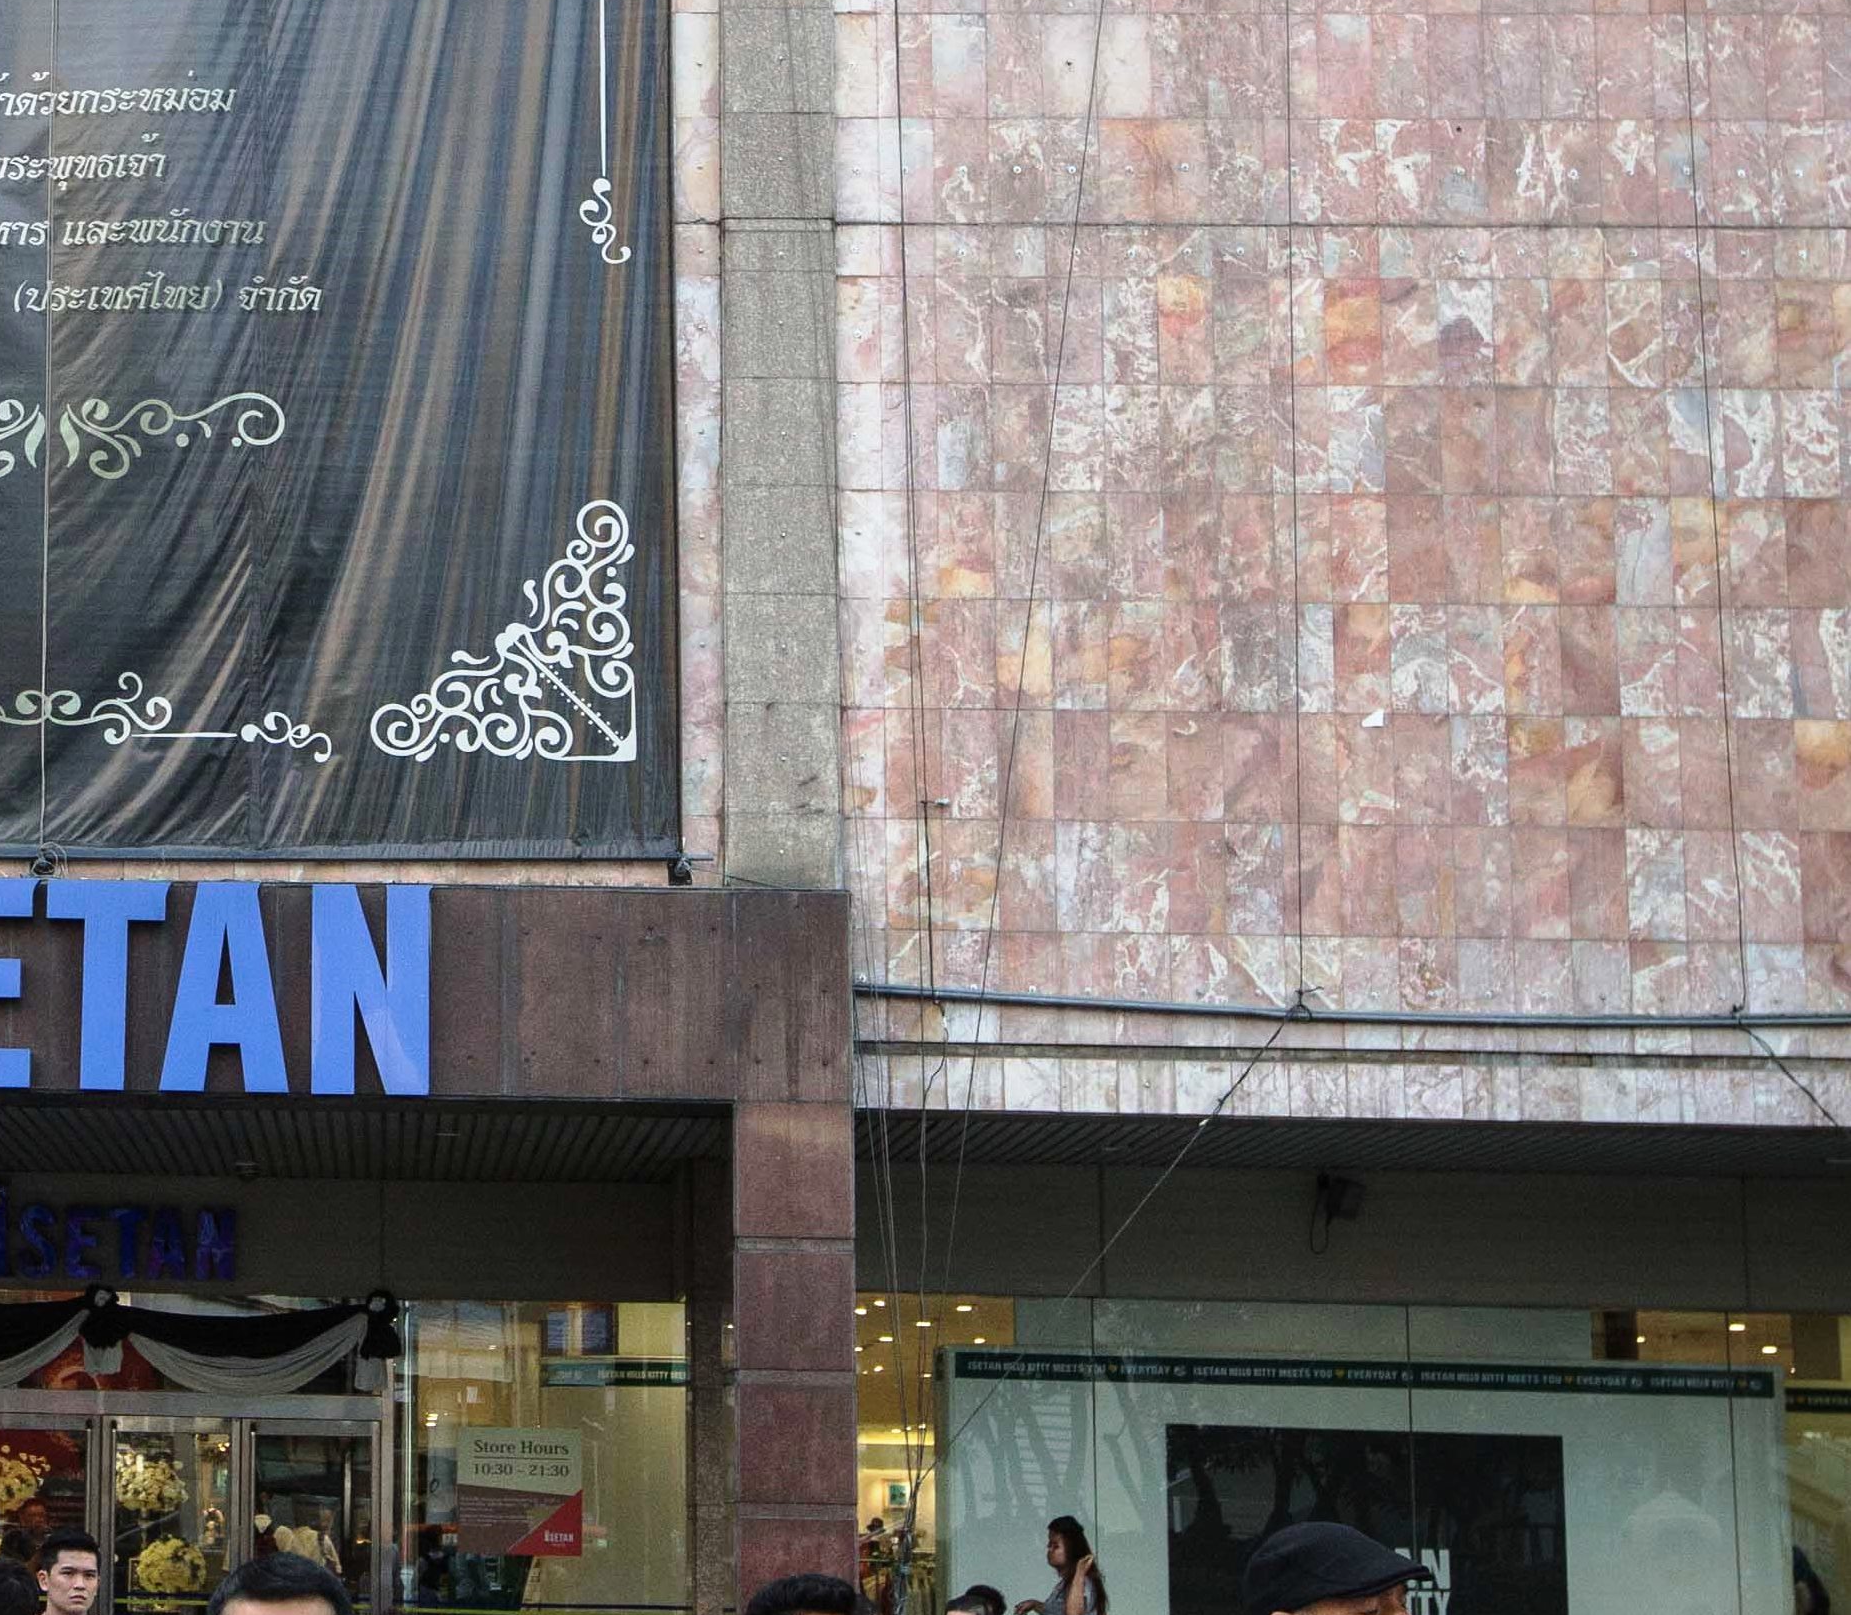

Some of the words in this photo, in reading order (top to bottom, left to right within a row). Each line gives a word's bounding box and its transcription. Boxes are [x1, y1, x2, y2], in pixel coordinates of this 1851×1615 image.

[63, 208, 267, 246] และพนักงาน
[237, 275, 324, 312] จำกัด
[473, 1439, 516, 1456] Store
[520, 1439, 570, 1456] Hours
[472, 1463, 513, 1476] 10:30
[528, 1463, 570, 1477] 21:30
